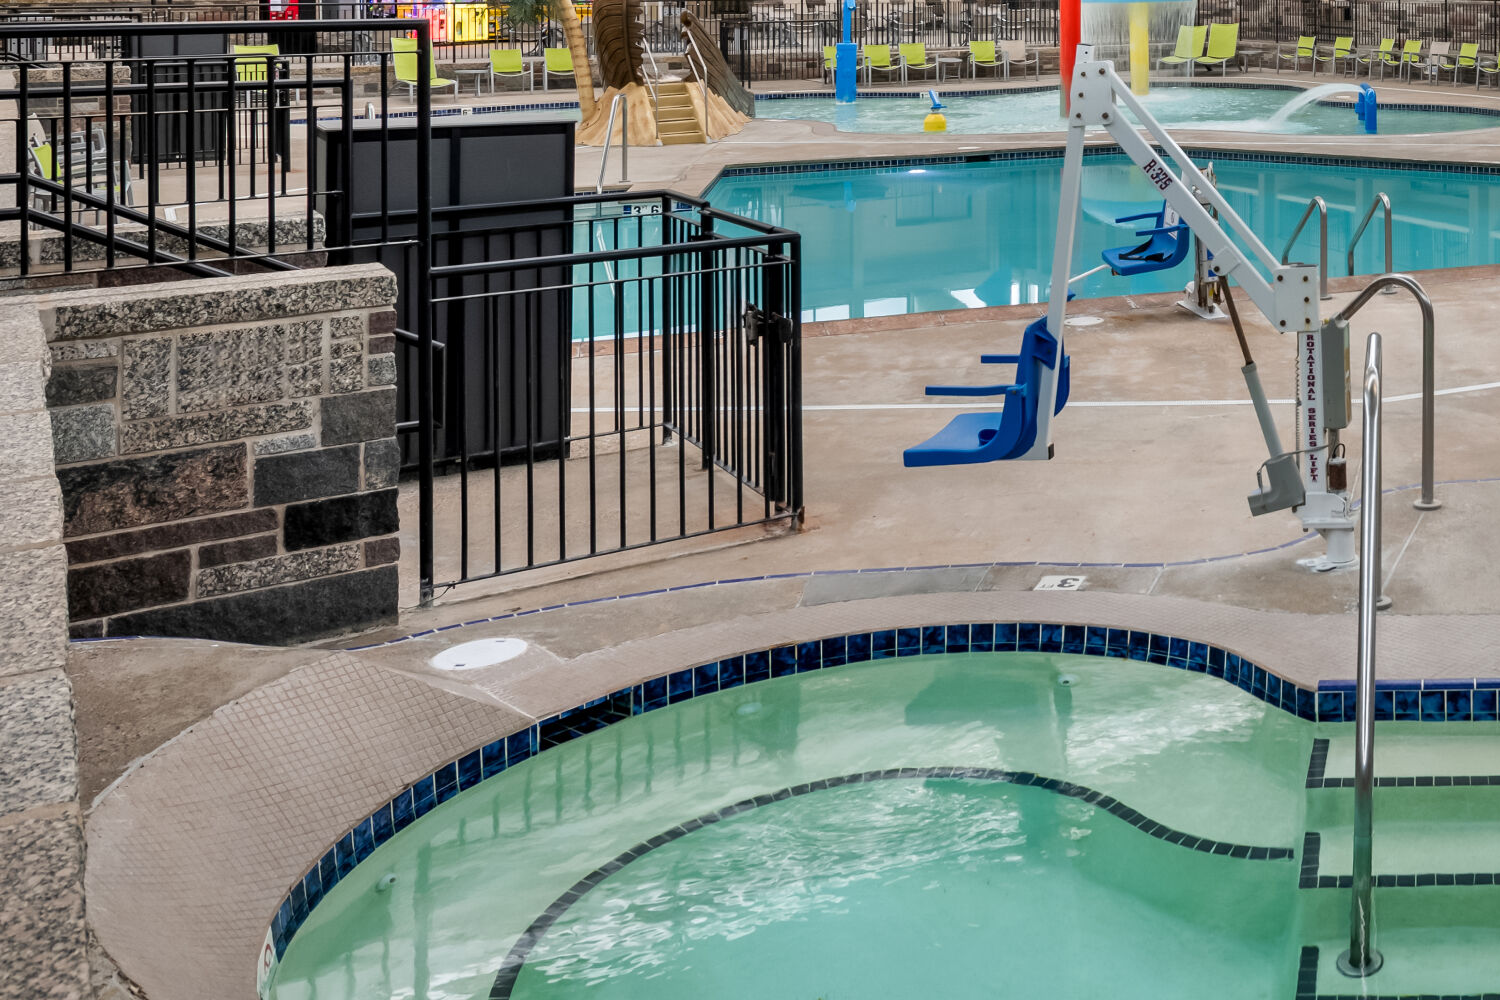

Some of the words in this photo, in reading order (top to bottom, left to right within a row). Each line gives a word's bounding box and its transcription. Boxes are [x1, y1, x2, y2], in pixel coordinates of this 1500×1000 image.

[1306, 334, 1316, 401] ROTATIONAL
[1307, 407, 1317, 447] SERIES
[1309, 454, 1319, 482] LIFT
[1057, 577, 1080, 588] 3
